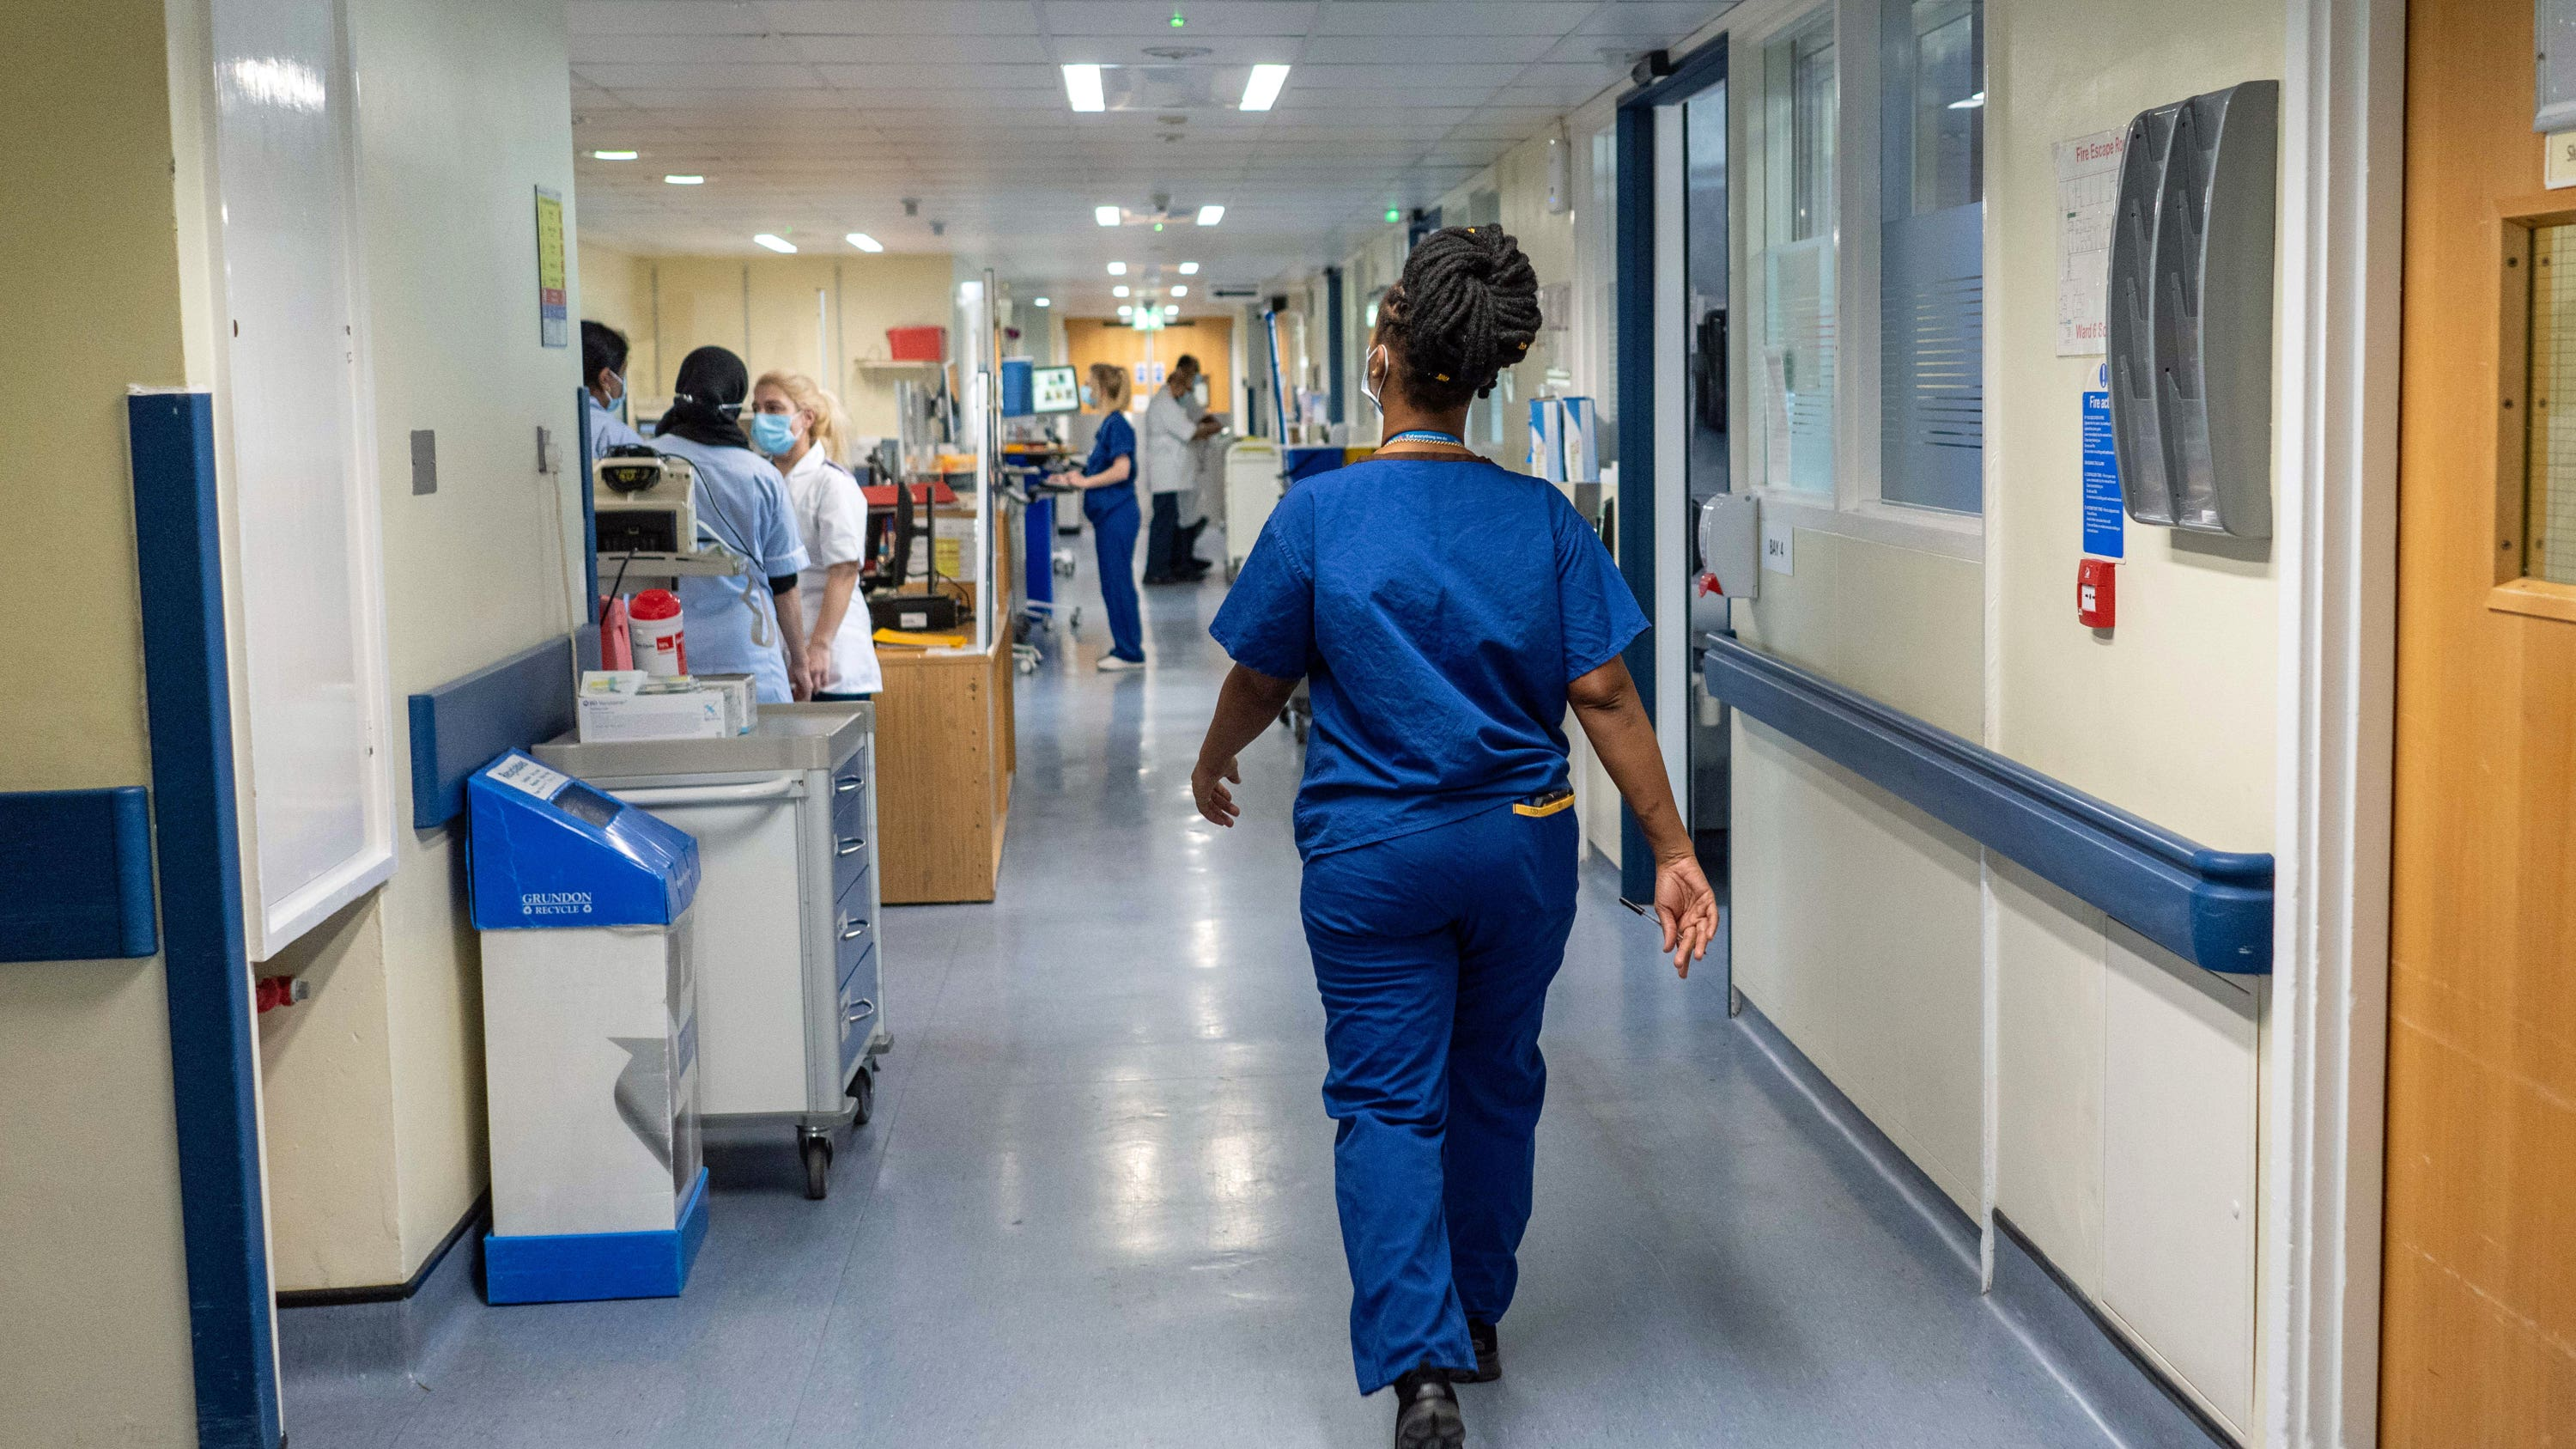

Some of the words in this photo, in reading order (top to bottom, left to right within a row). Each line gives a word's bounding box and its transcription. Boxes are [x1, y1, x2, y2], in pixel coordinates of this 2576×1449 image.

[2076, 146, 2089, 162] Fire
[2091, 142, 2114, 159] Escape
[2076, 323, 2092, 339] Ward
[2093, 323, 2096, 338] 6
[2090, 396, 2099, 408] Fire
[1770, 539, 1779, 557] BAY
[1780, 541, 1783, 557] 4
[522, 892, 592, 904] GRUNDON
[535, 905, 579, 915] RECYCLE
